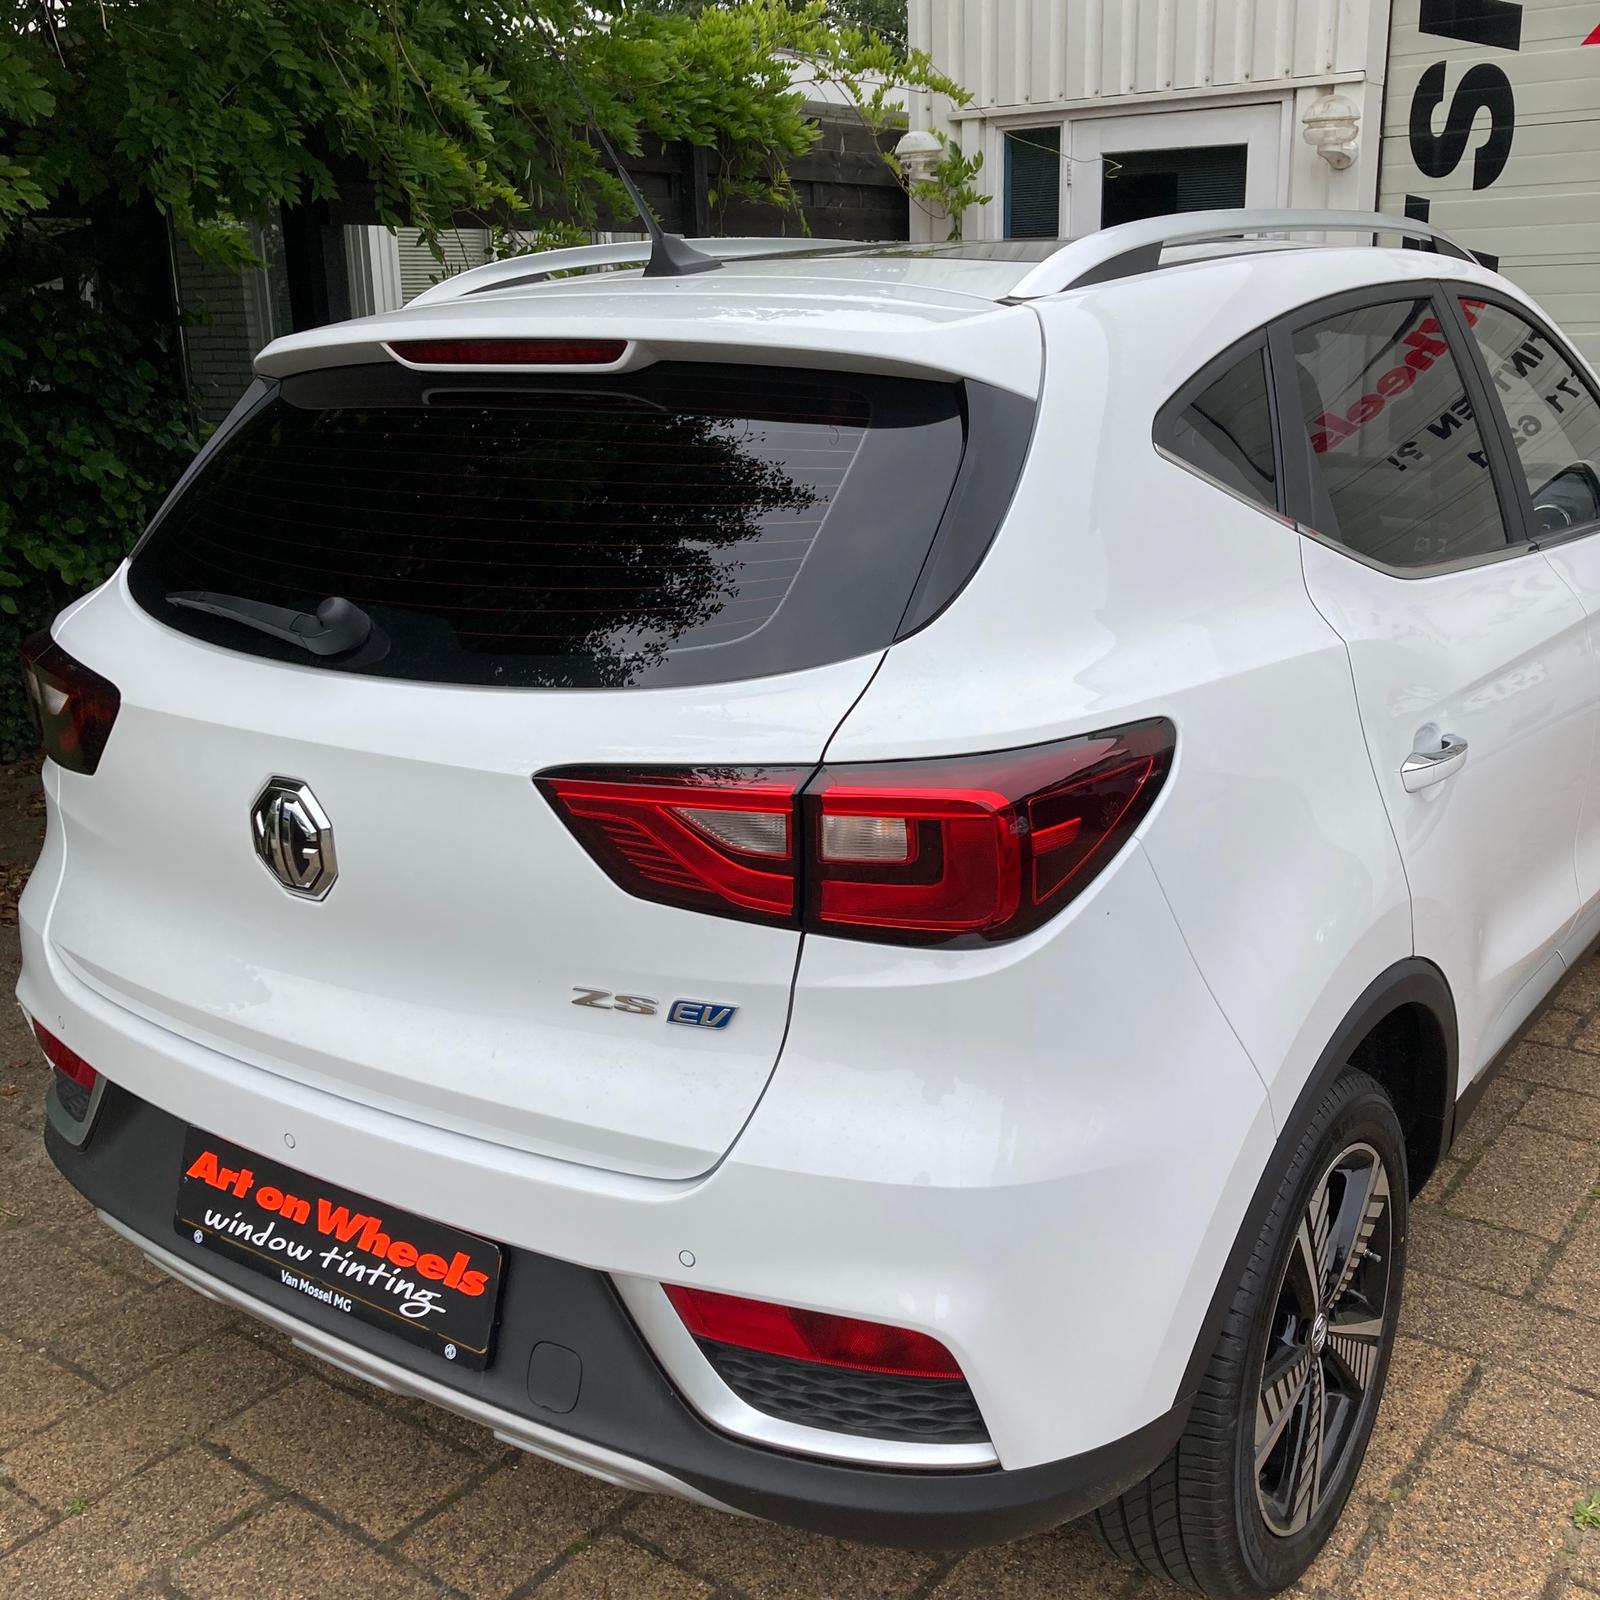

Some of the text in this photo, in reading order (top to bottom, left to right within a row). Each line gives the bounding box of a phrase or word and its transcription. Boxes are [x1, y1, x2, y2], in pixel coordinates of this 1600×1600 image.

[571, 985, 733, 1027] ZS EV
[187, 1151, 489, 1297] Art on Wheels
[204, 1208, 447, 1318] window tinting
[281, 1269, 352, 1314] Van Mossel MG
